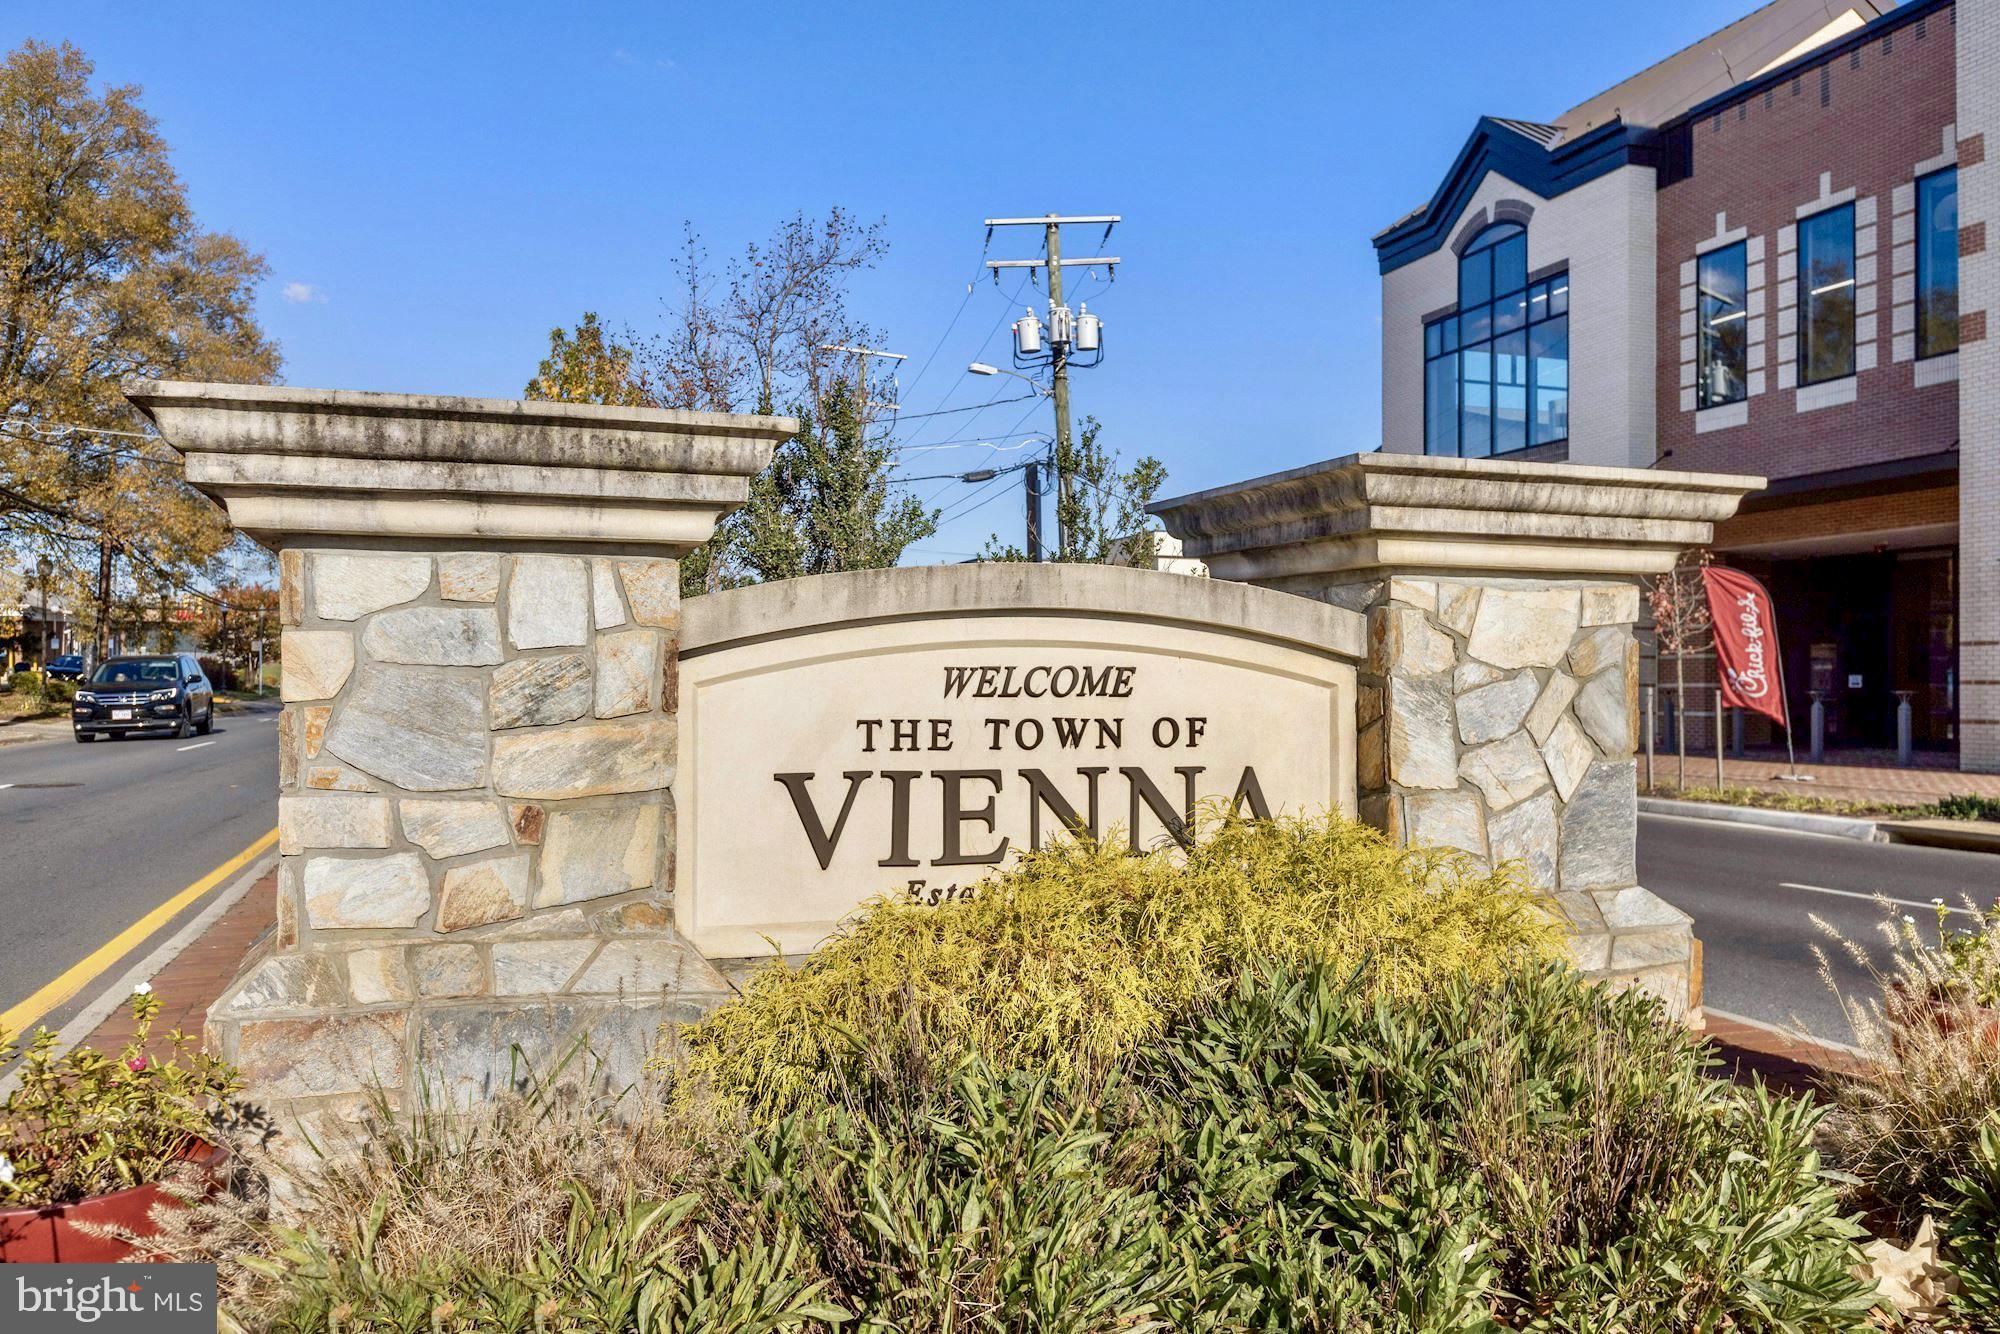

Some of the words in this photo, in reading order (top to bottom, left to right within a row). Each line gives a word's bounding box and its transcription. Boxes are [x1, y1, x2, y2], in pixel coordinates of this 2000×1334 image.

[943, 665, 1136, 699] WELCOME
[856, 718, 954, 752] THE
[984, 717, 1125, 751] TOWN
[1151, 716, 1208, 749] OF
[774, 765, 1275, 871] VIENNA
[904, 879, 991, 907] Esta
